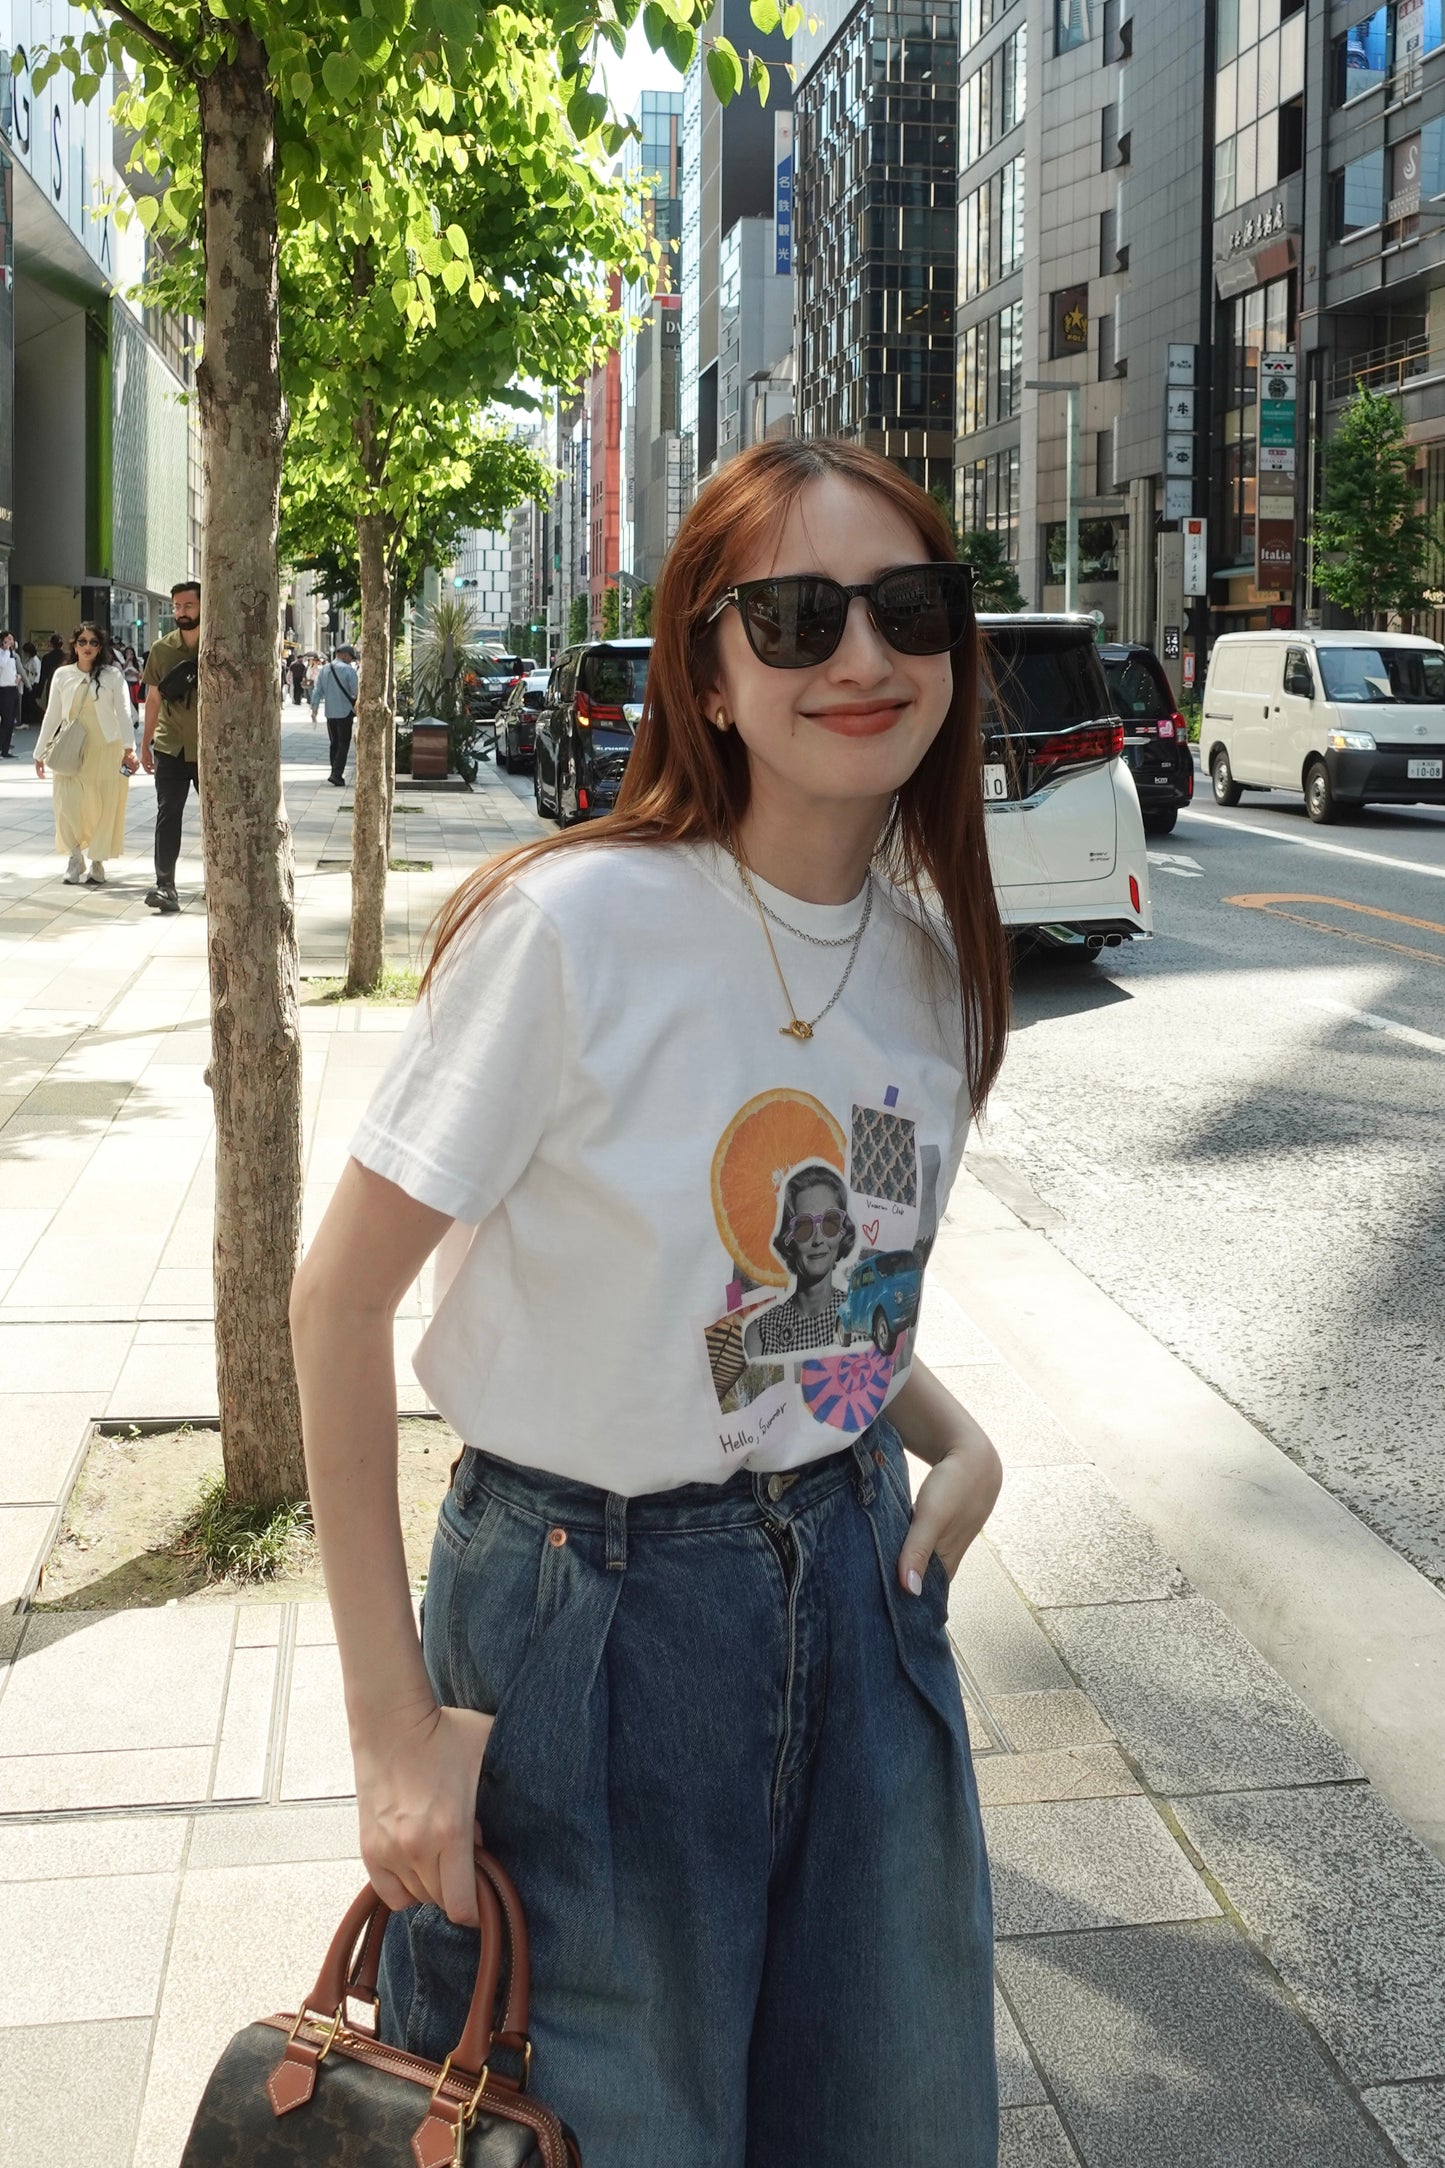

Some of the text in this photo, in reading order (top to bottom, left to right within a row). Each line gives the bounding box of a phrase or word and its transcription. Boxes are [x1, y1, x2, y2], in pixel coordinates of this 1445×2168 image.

[777, 176, 790, 261] 名鉄観光
[719, 1430, 760, 1454] Hello,
